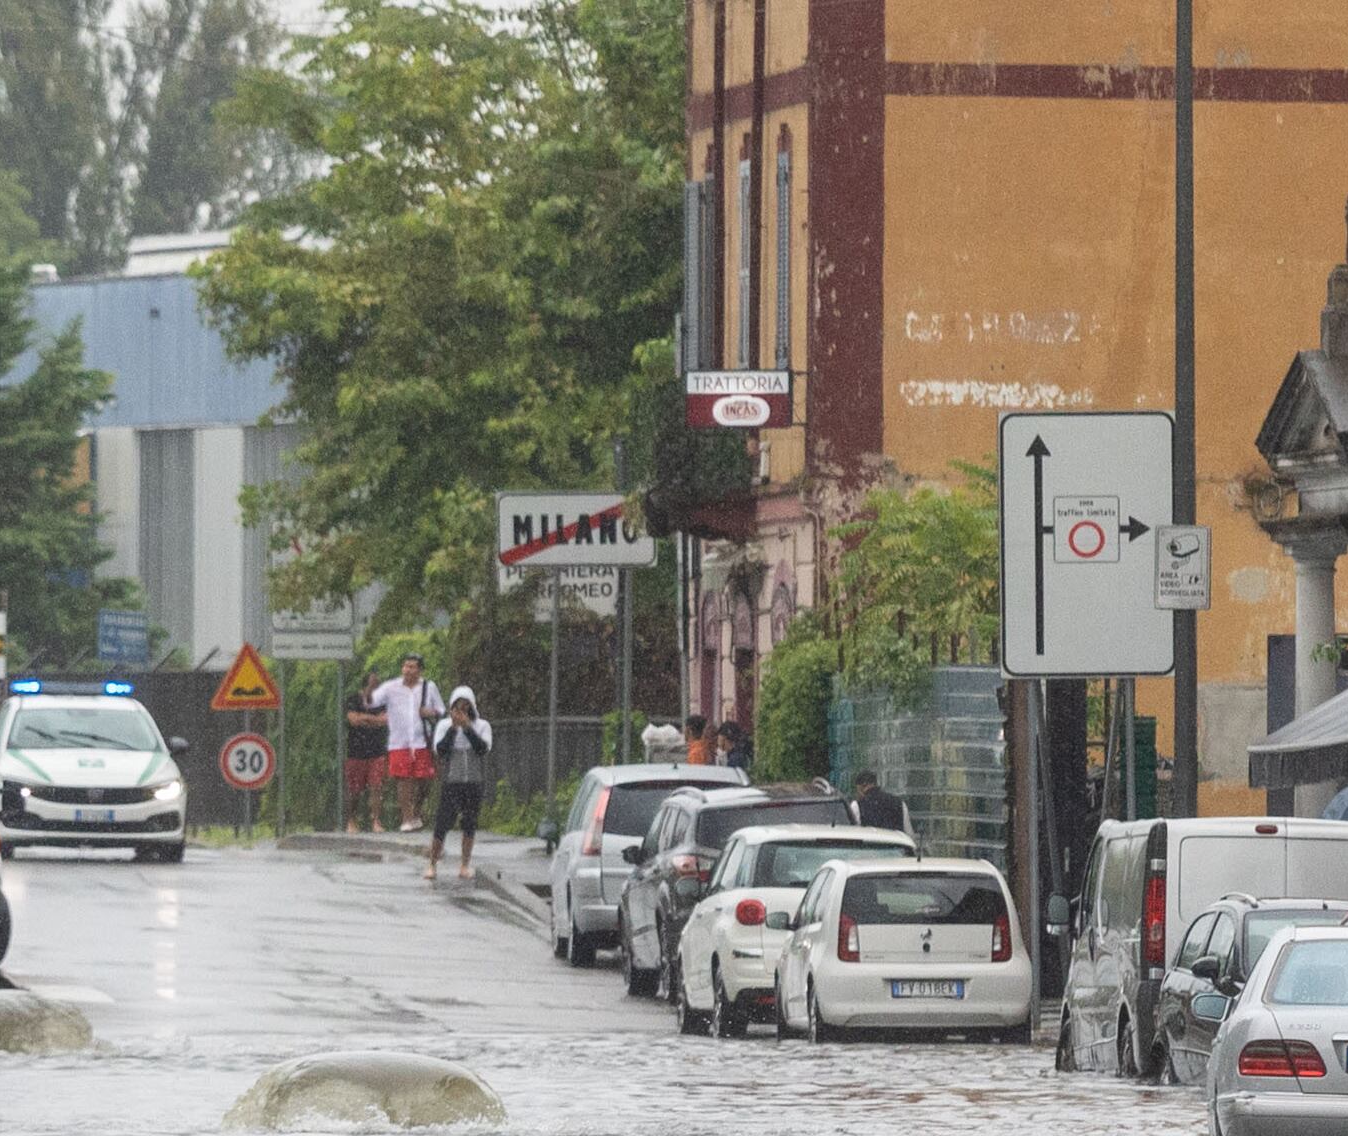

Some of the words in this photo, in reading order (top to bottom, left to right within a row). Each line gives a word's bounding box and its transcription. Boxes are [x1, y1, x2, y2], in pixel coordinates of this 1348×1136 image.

[694, 376, 784, 391] TRATTORIA
[512, 513, 638, 545] MILANO
[235, 748, 264, 774] 30
